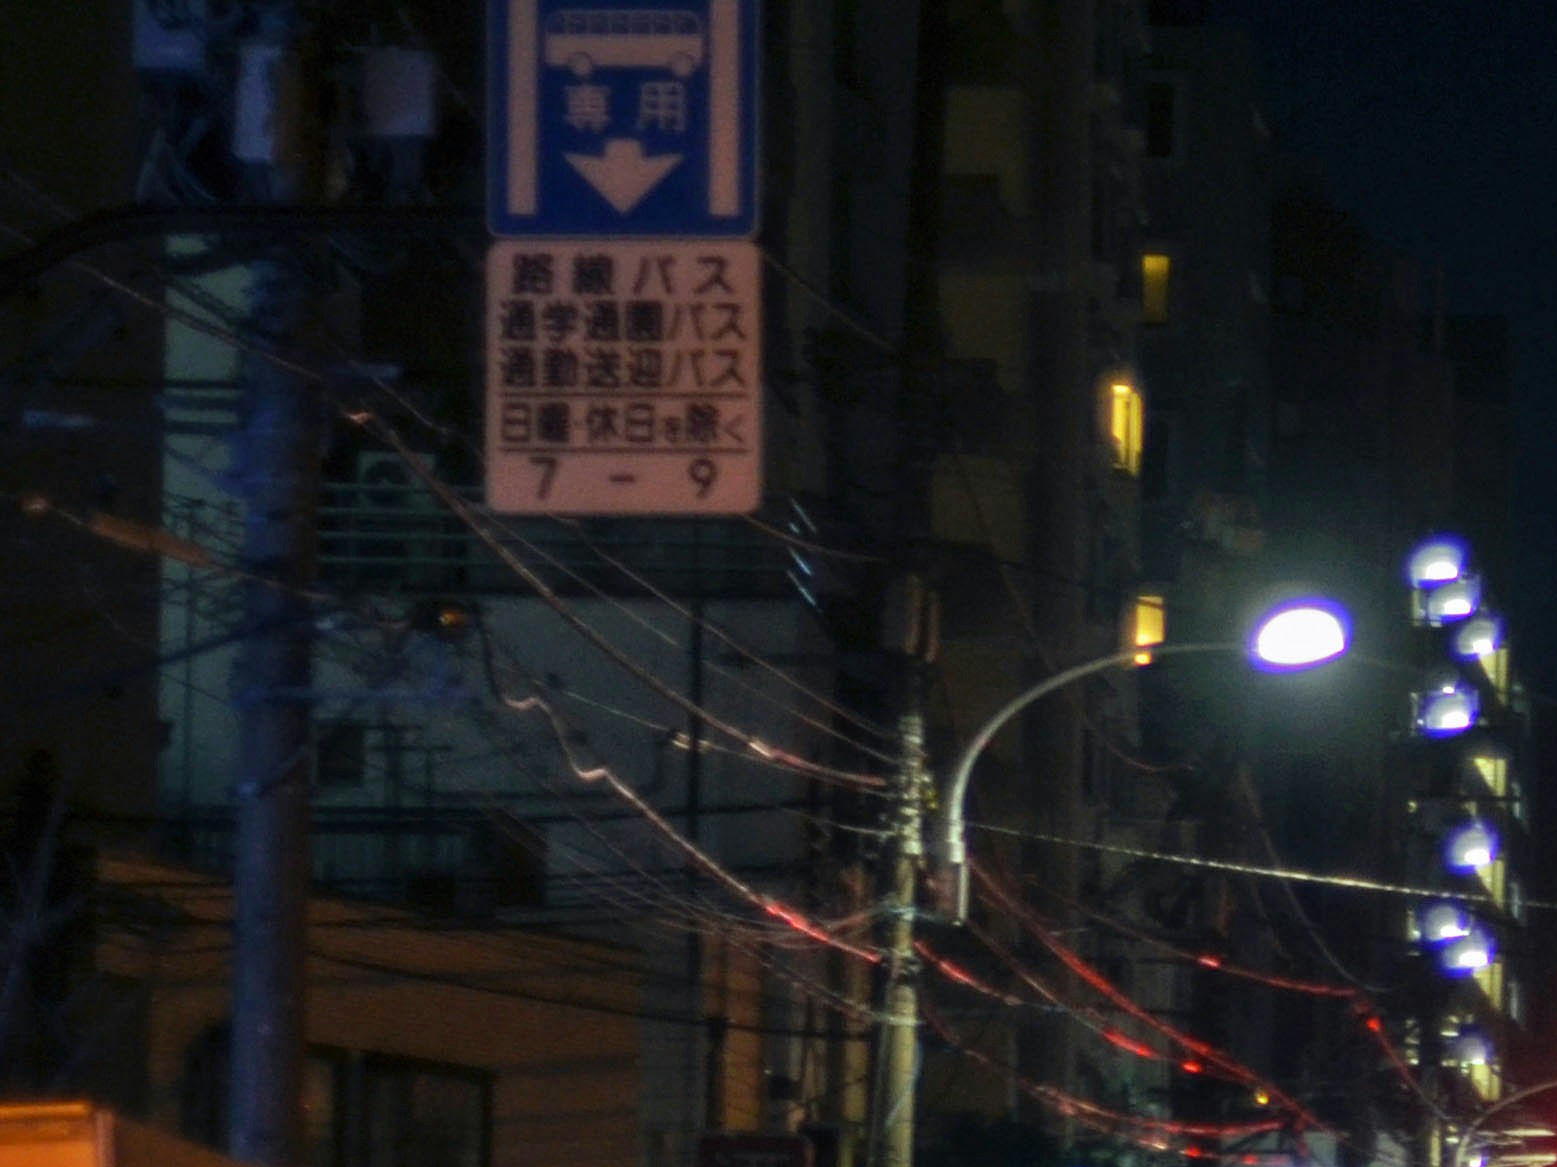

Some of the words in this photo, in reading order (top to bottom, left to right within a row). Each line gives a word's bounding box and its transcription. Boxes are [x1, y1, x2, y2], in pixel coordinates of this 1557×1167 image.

[562, 82, 686, 132] 専用
[511, 253, 735, 294] 路線バス
[500, 301, 746, 341] 通学通園バス
[500, 347, 746, 388] 通勤送迎バス
